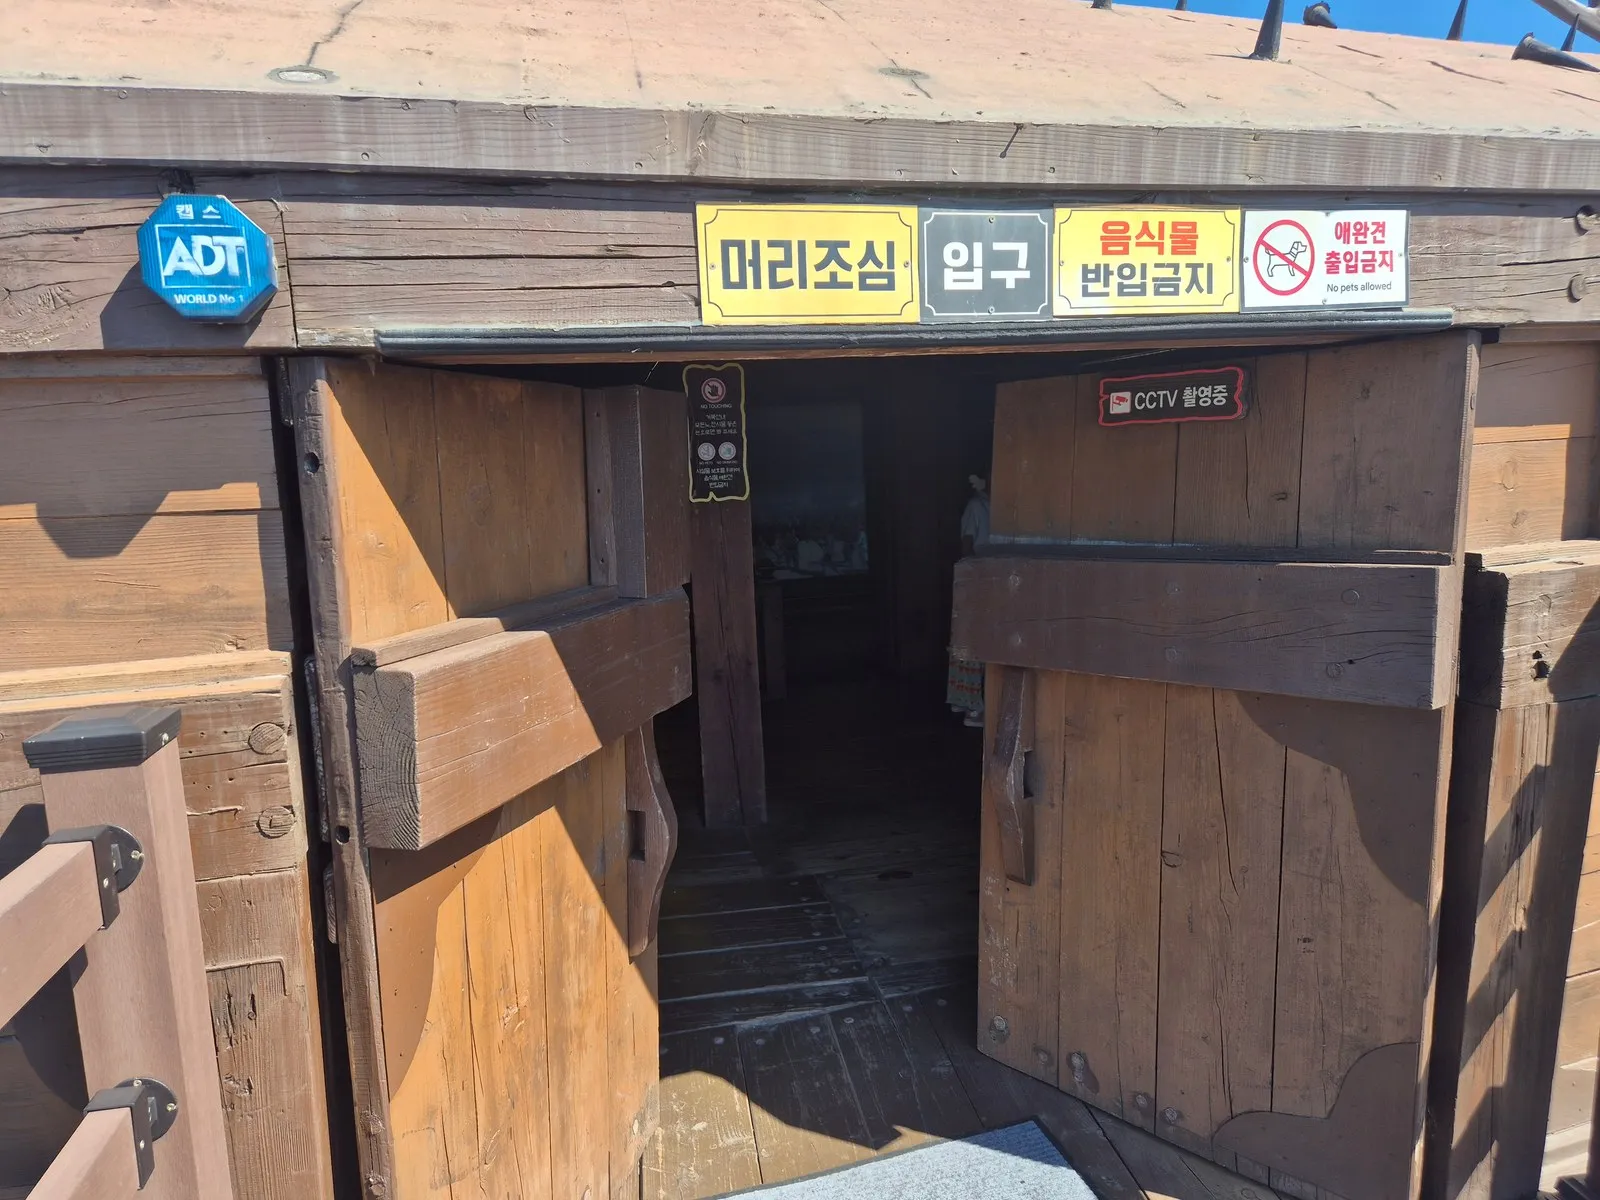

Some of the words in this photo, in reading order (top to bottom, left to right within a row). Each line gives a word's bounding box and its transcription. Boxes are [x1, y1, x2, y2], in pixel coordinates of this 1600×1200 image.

[1100, 220, 1199, 256] 음식물
[1334, 221, 1386, 245] 애완견
[163, 235, 247, 277] ADT
[720, 239, 896, 291] 머리조심
[943, 241, 1031, 291] 입구
[1324, 250, 1394, 275] 출입금지
[1081, 263, 1213, 298] 반입금지
[1327, 283, 1338, 292] No
[1340, 282, 1359, 294] pets
[1360, 281, 1392, 291] allowed
[174, 293, 217, 304] WORLD
[1134, 389, 1178, 410] CCTV
[1182, 384, 1228, 408] 촬영중
